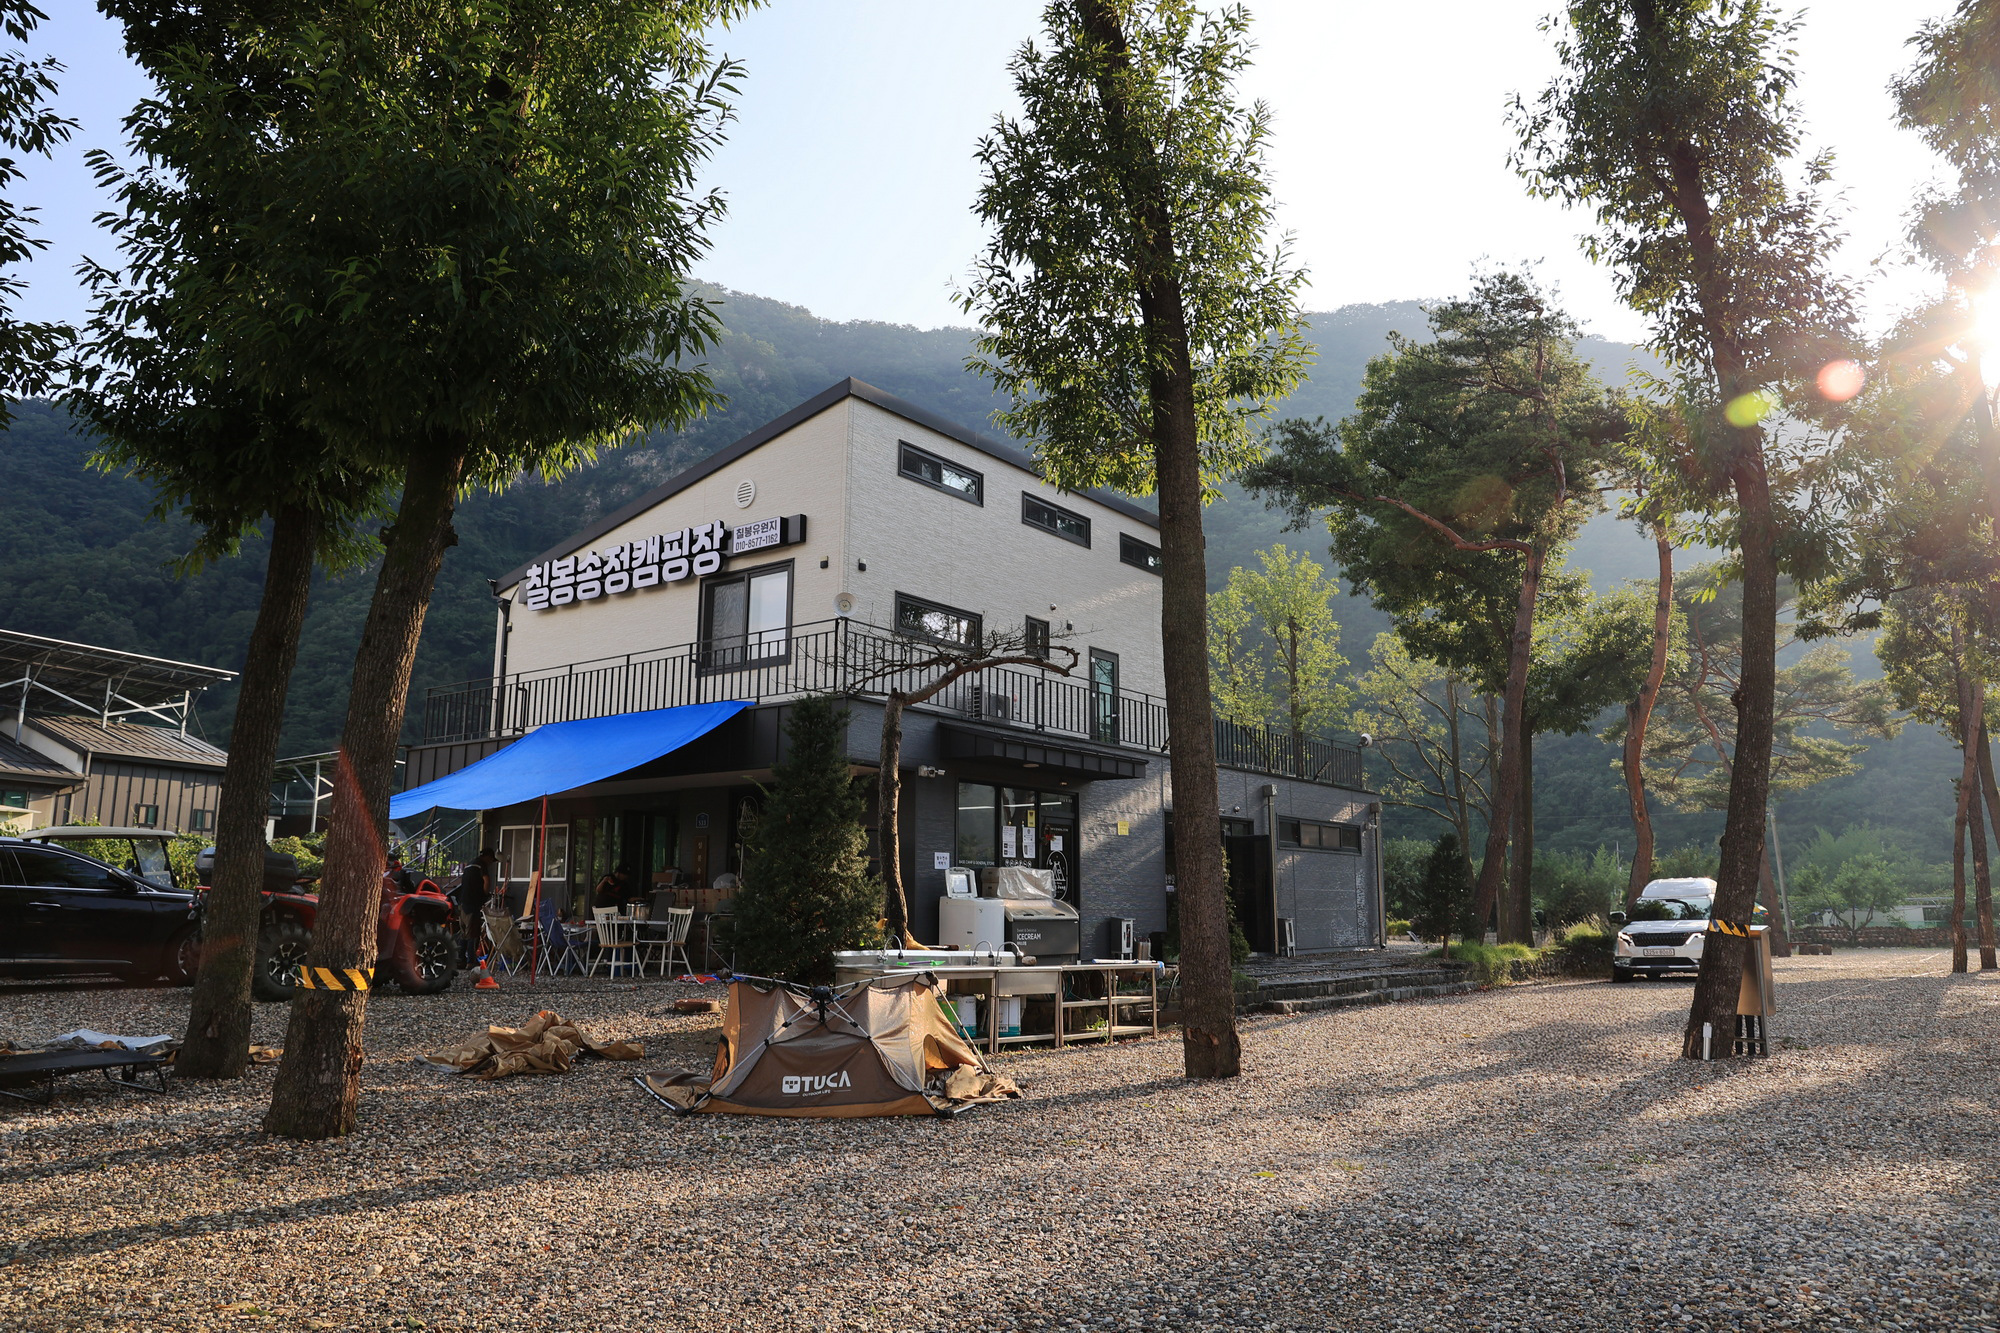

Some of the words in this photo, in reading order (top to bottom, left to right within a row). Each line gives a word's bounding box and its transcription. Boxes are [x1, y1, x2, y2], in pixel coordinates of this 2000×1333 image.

[736, 520, 777, 539] 칠봉유원지
[526, 520, 724, 611] 칠봉송정캠핑장
[801, 1070, 851, 1092] TUCA
